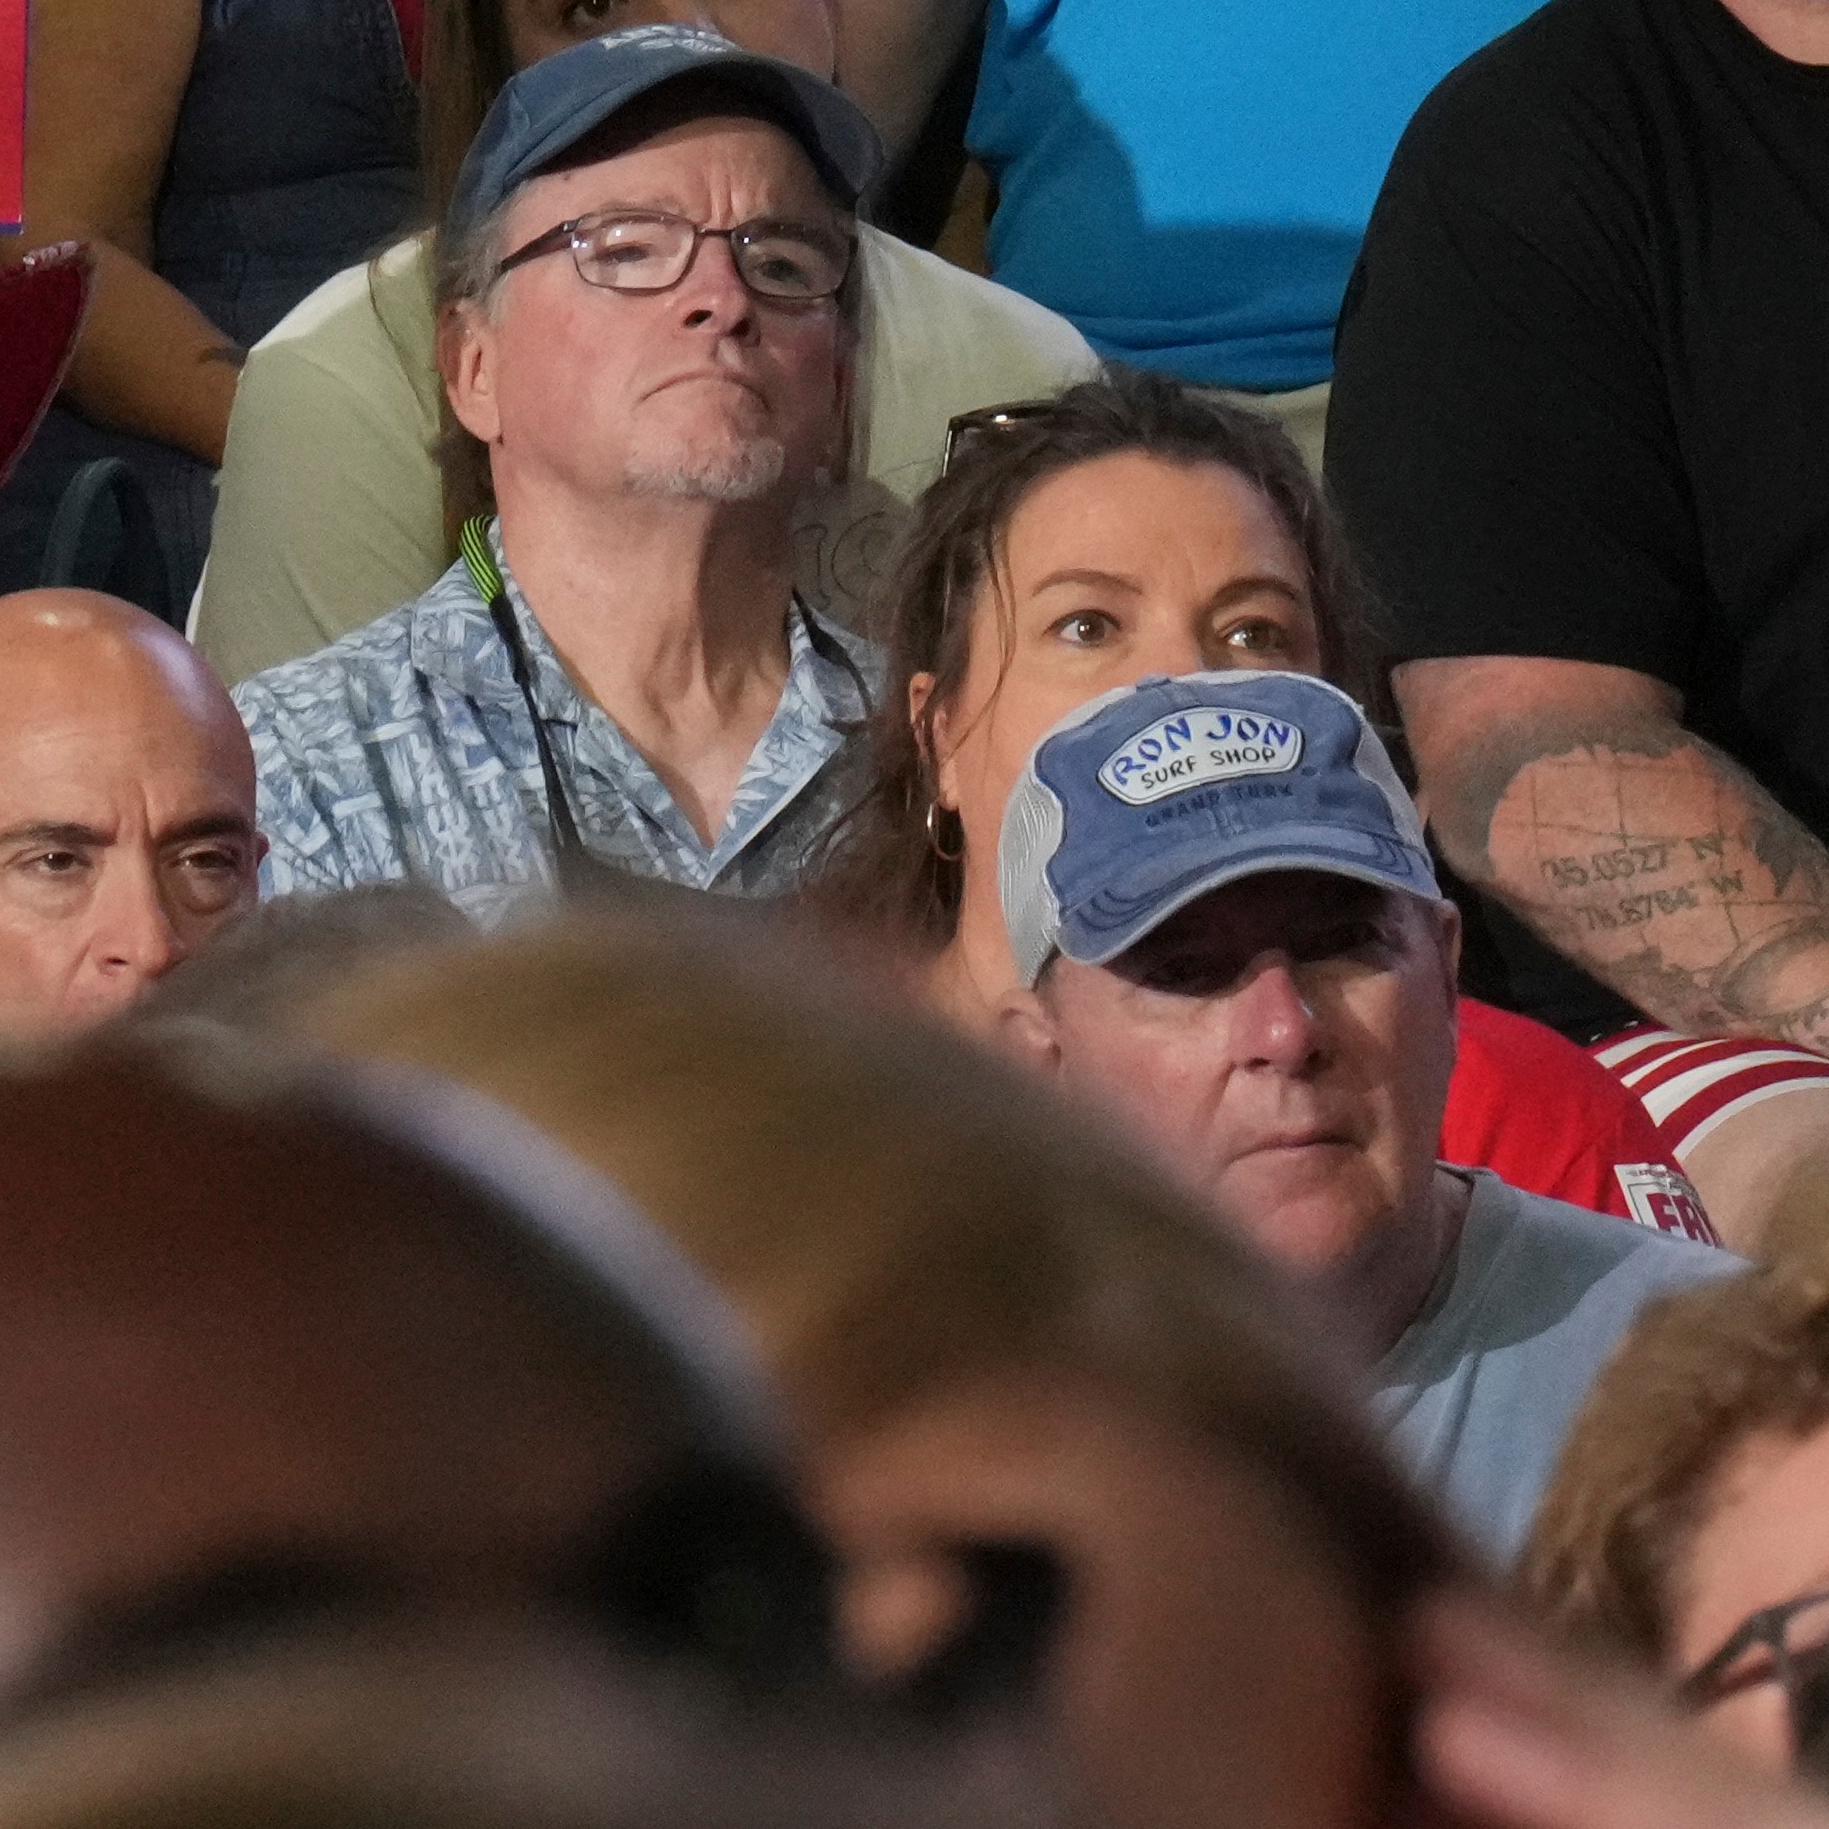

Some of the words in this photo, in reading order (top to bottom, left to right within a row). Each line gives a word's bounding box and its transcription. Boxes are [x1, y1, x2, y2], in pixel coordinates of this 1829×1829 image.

[1111, 717, 1193, 786] RON
[1205, 714, 1290, 748] JON
[1141, 755, 1198, 789] SURF
[1210, 746, 1276, 768] SHOP
